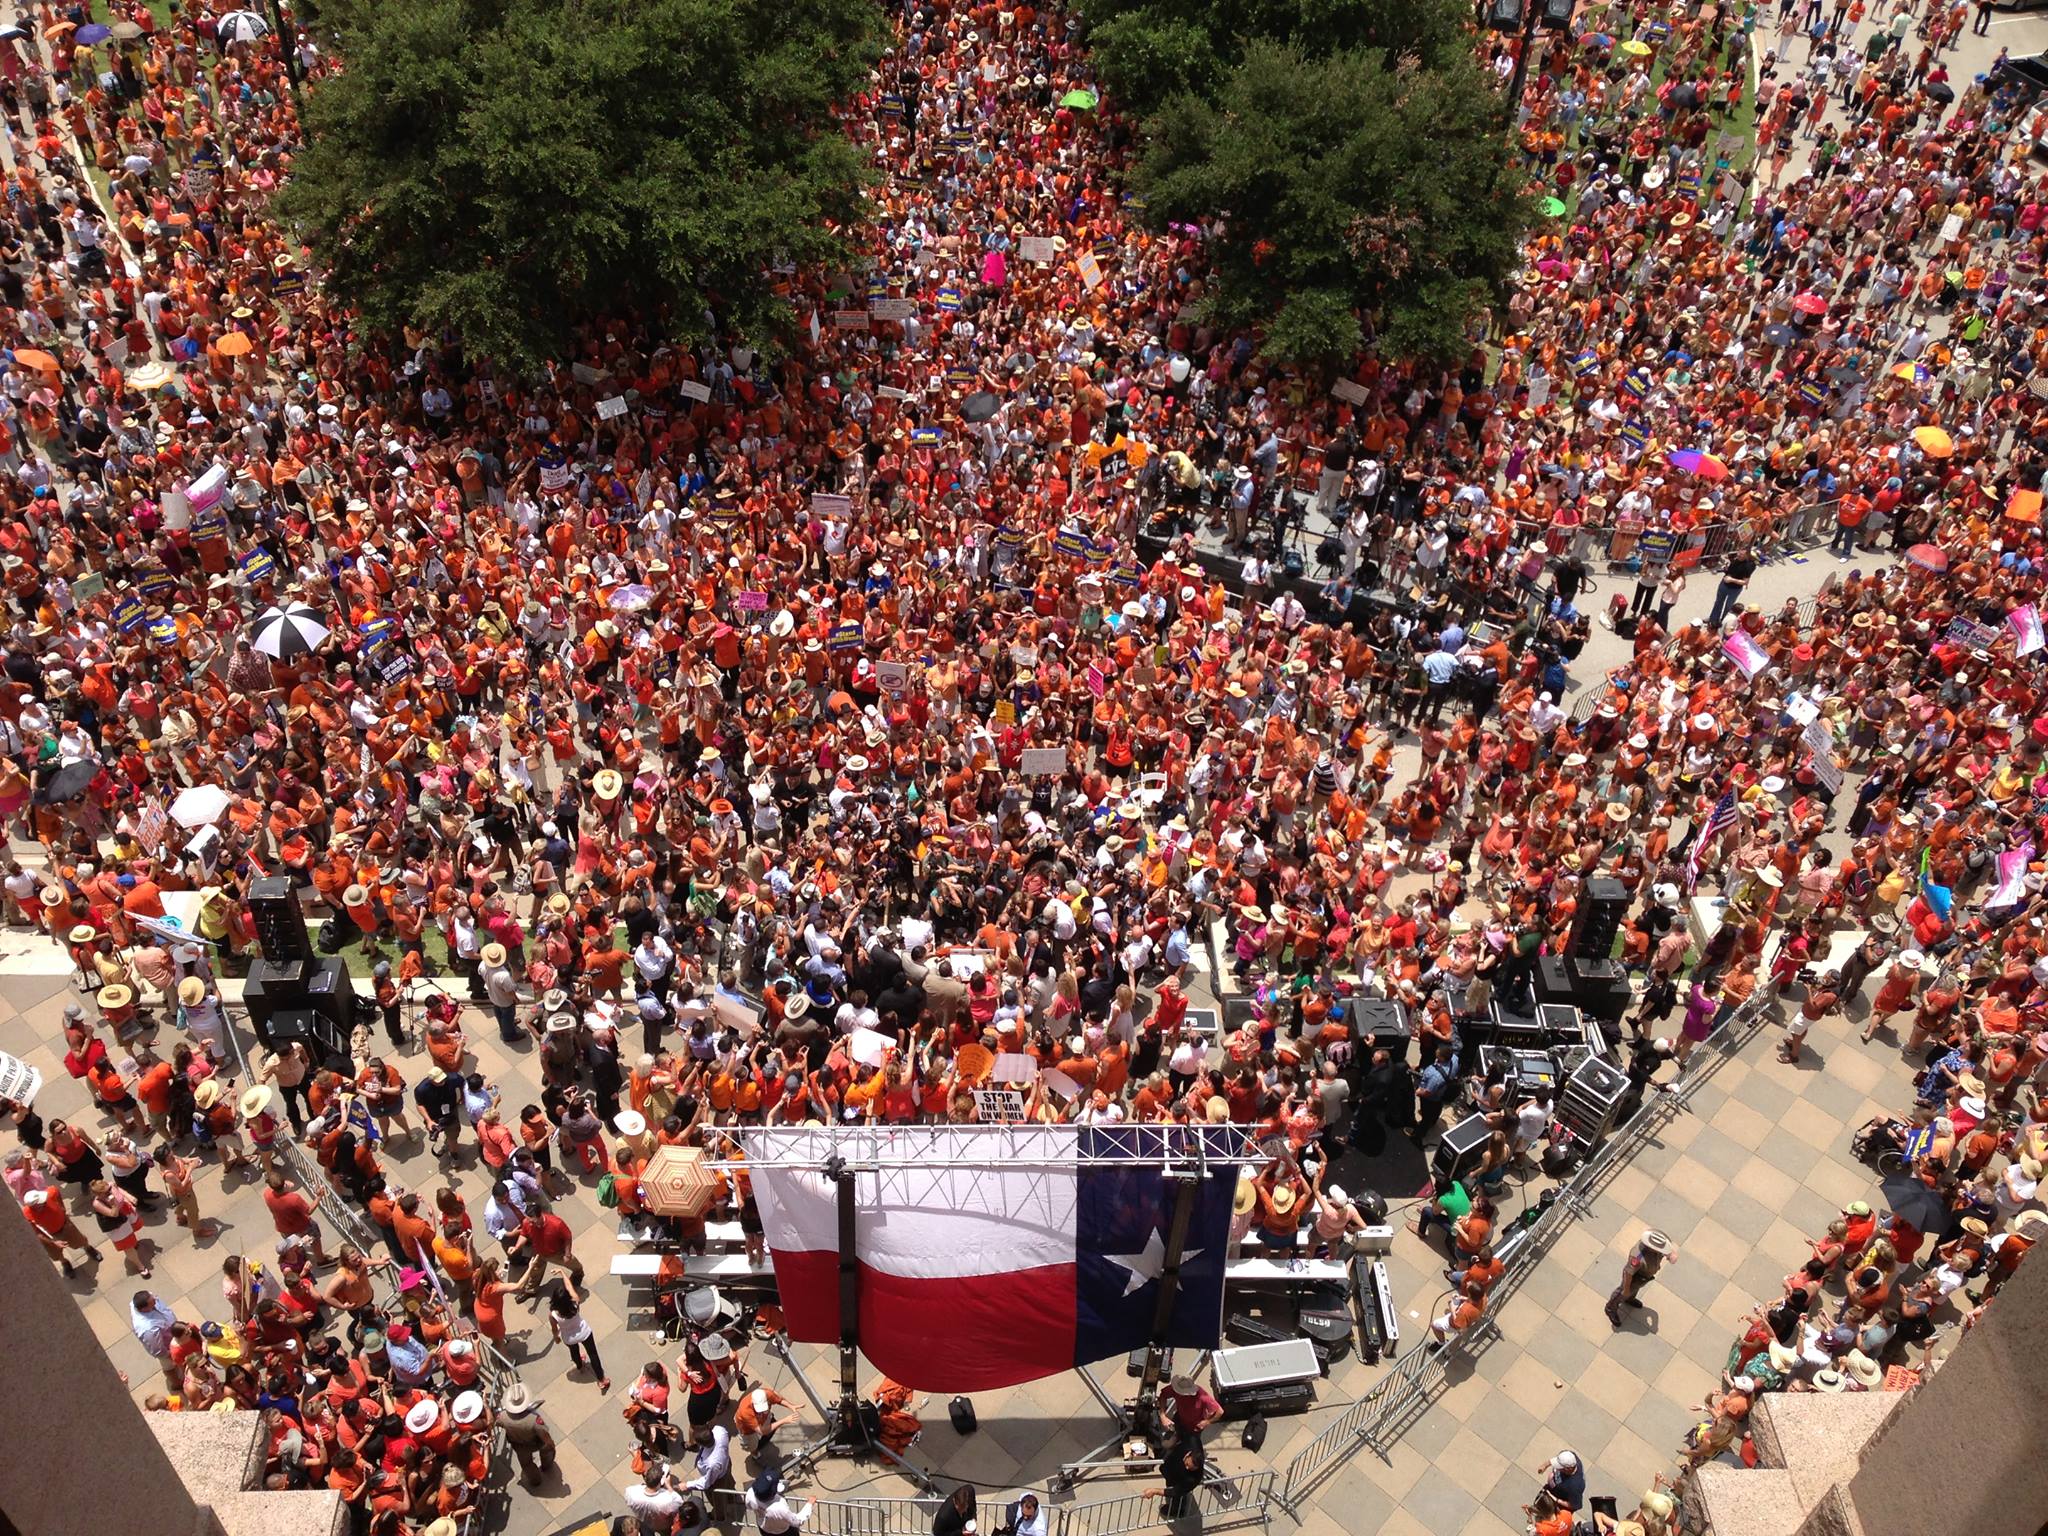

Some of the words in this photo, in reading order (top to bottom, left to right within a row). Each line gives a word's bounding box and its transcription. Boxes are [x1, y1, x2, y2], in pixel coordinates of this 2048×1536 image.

[983, 1092, 1013, 1103] STOP
[979, 1103, 998, 1111] THE
[981, 1111, 993, 1120] ON
[993, 1111, 1025, 1121] WMEN
